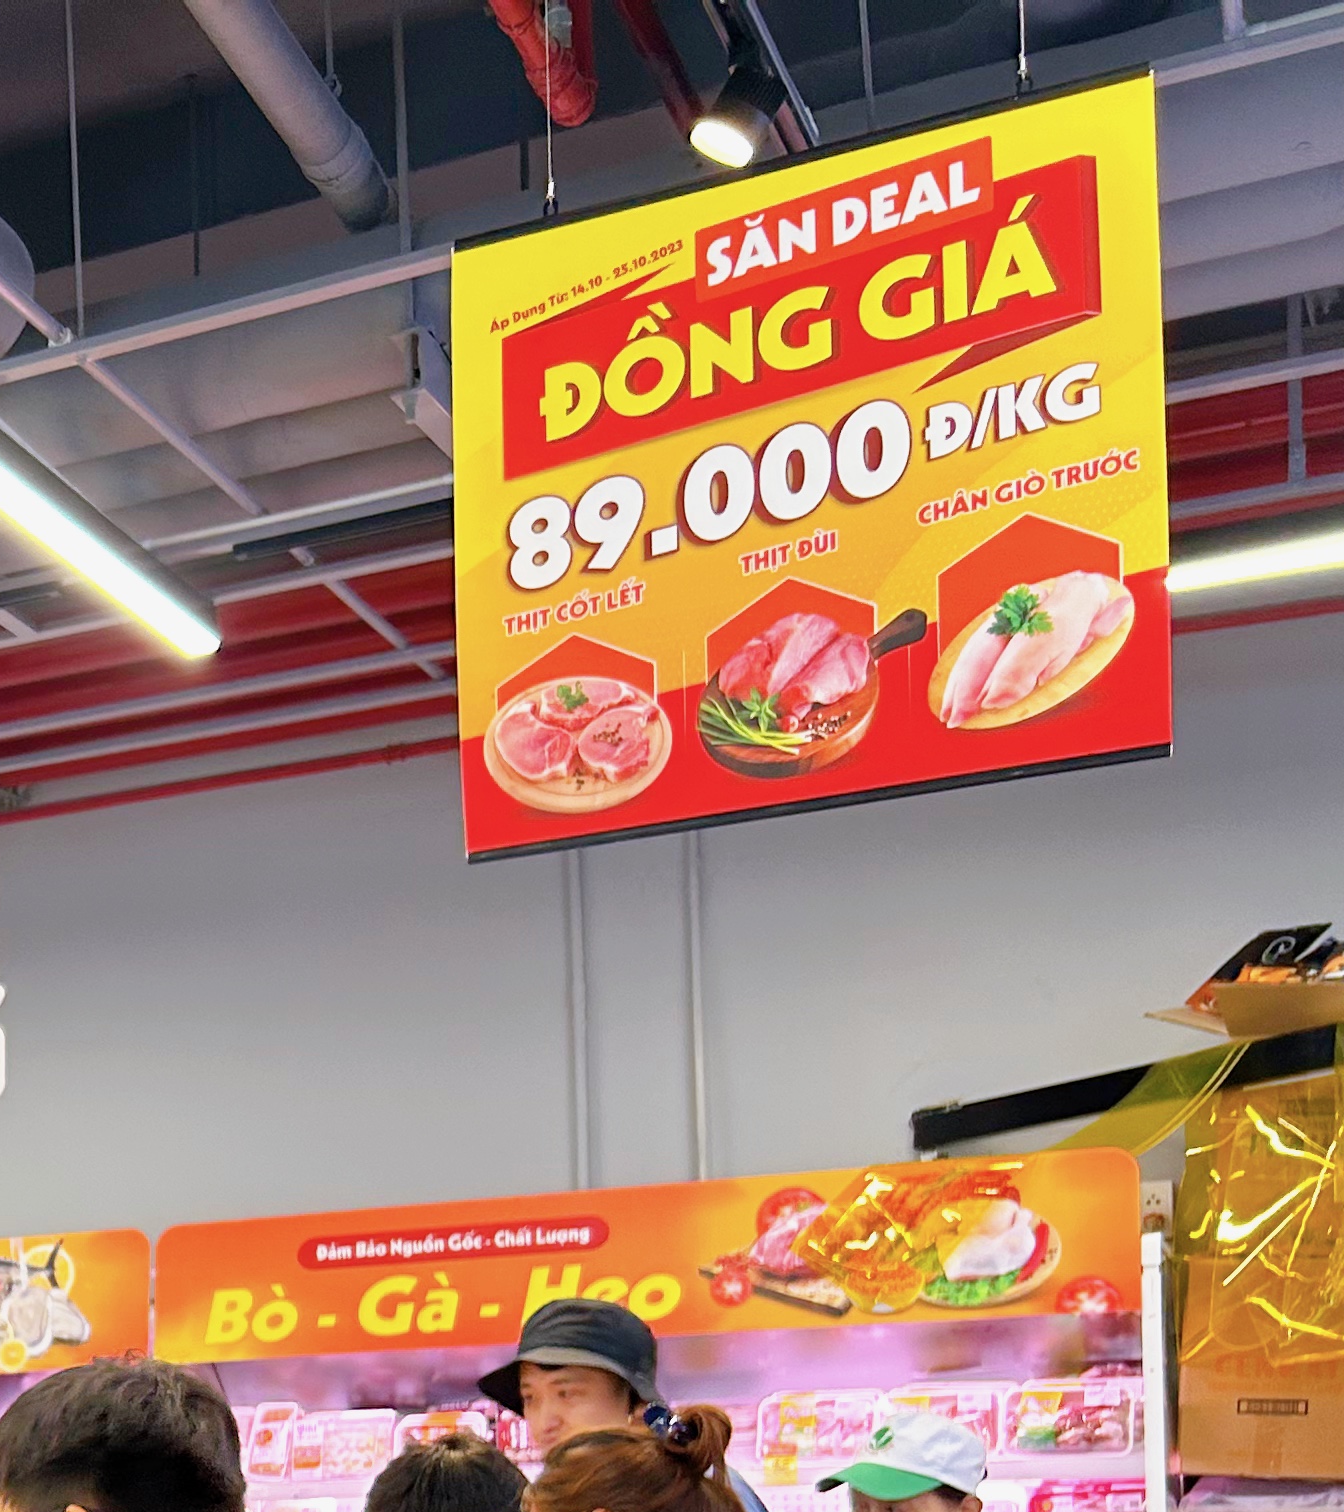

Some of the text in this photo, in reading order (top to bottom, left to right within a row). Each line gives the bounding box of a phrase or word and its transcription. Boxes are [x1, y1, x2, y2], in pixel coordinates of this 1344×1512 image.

[706, 161, 981, 287] SĂN DEAL
[490, 316, 510, 334] Áp
[512, 302, 546, 323] Dụng
[571, 275, 602, 299] 14.10
[613, 239, 684, 279] 25.10.2023
[539, 194, 1057, 442] ĐỒNG GIÁ
[506, 361, 1102, 591] 89.000 Đ/KG
[917, 446, 1141, 526] CHÂN GIÒ TRƯỚC
[740, 529, 838, 577] THỊT ĐÙI
[503, 578, 645, 637] THỊT CỐT LẾT
[317, 1240, 352, 1262] Đảm
[356, 1236, 387, 1259] Bảo
[390, 1235, 445, 1259] Nguồn
[448, 1230, 482, 1252] Gốc
[494, 1225, 532, 1249] Chất
[535, 1225, 591, 1248] Lượng
[204, 1283, 299, 1346] Bò
[317, 1312, 337, 1329] -
[358, 1271, 460, 1337] Gà
[478, 1302, 500, 1319] -
